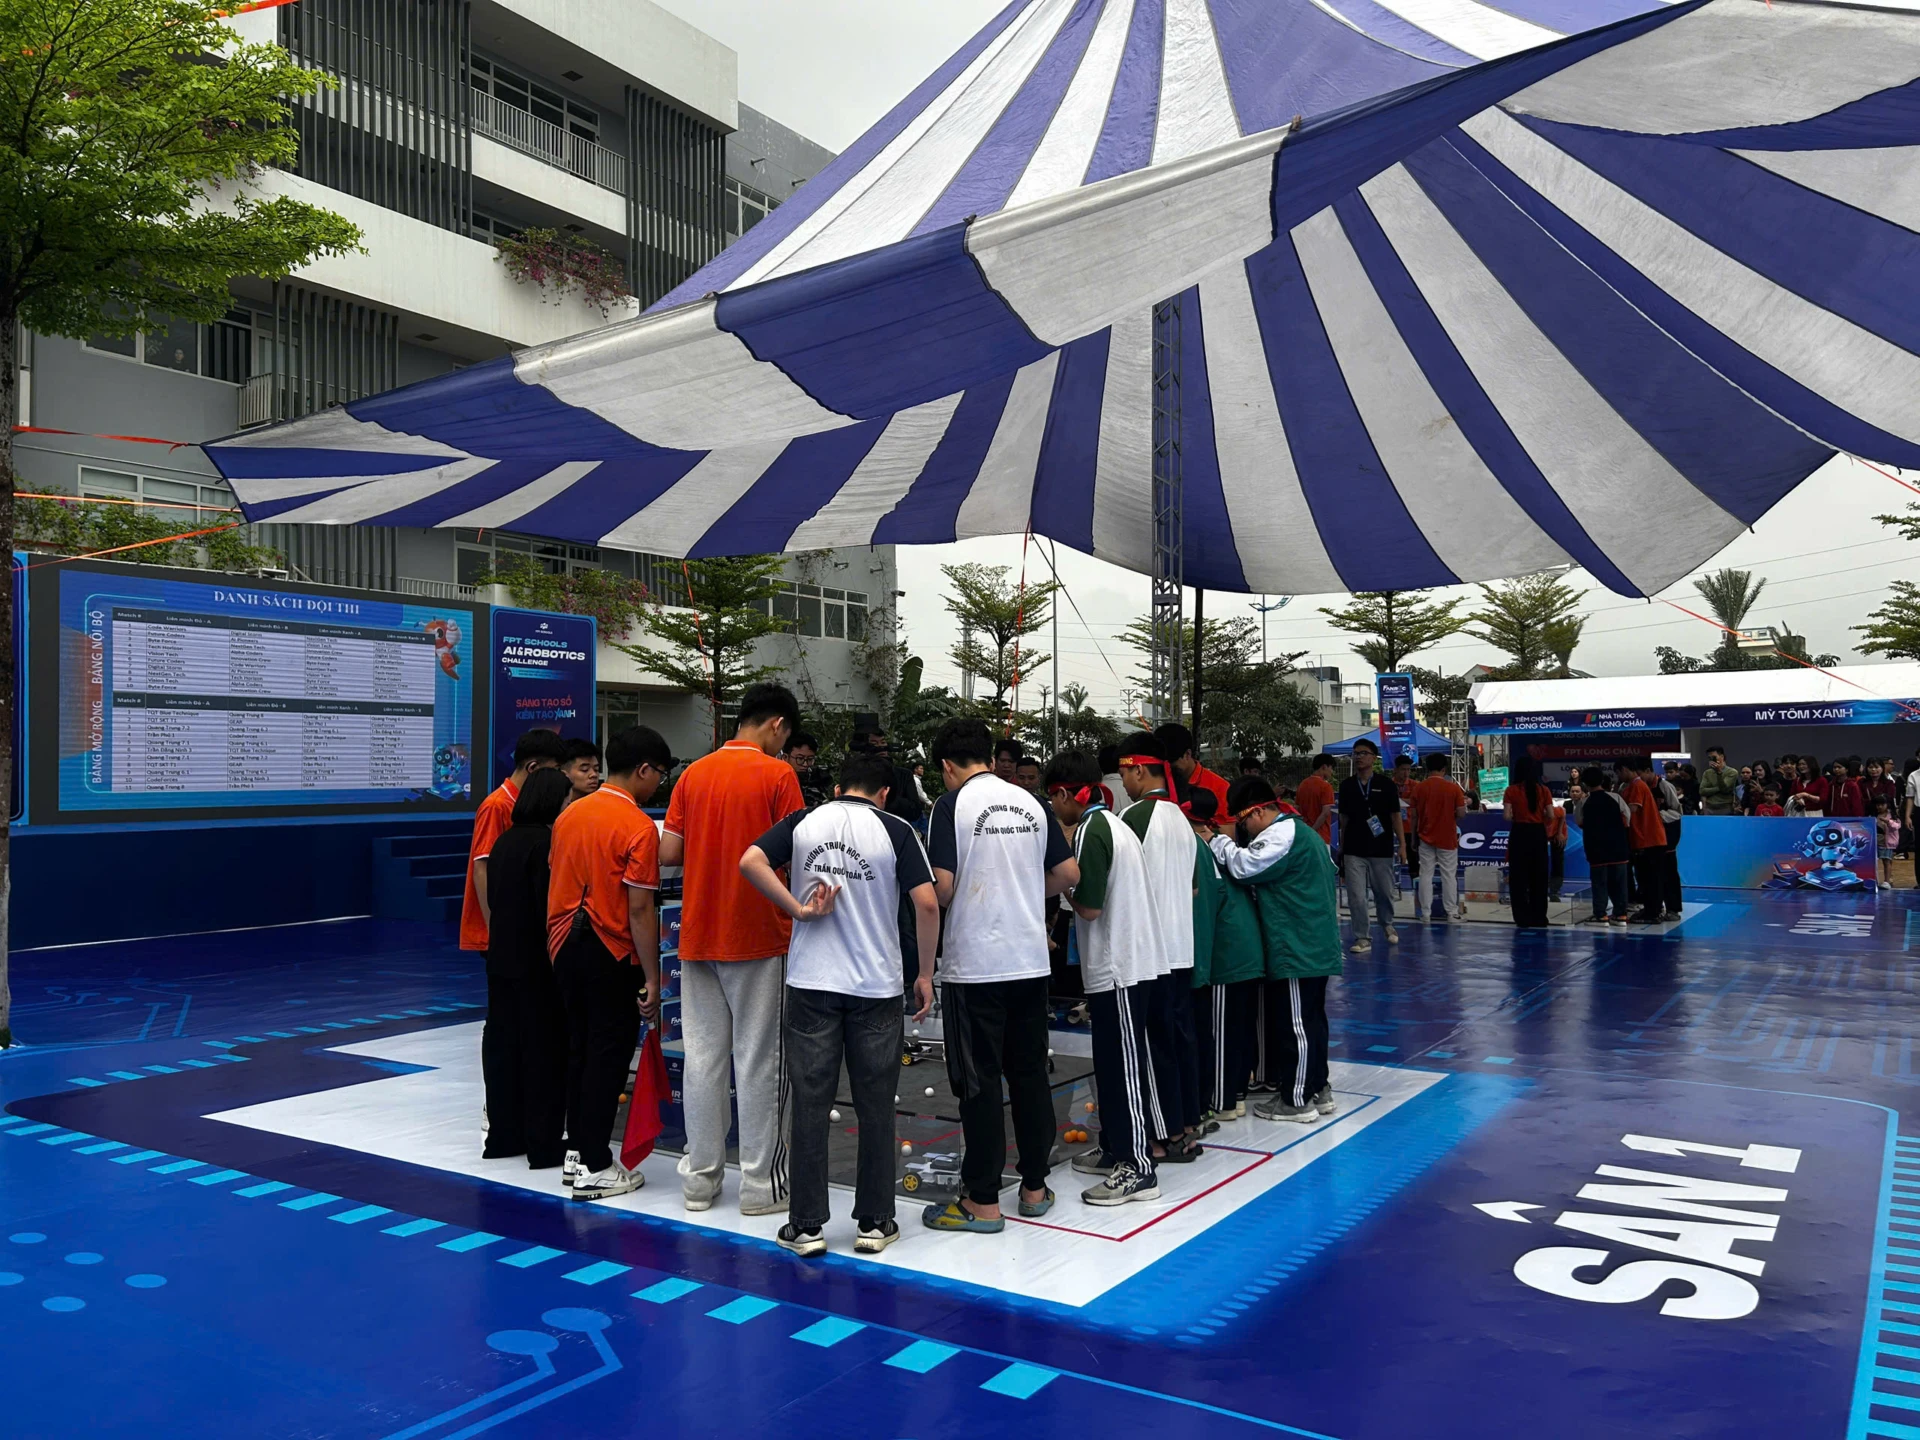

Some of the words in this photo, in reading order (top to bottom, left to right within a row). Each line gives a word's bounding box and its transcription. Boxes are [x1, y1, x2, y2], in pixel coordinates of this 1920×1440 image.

[215, 591, 258, 605] DANH
[262, 594, 302, 609] SÁCH
[307, 600, 332, 613] ĐỘI
[336, 603, 360, 614] THI
[524, 638, 567, 648] SCHOOLS
[503, 646, 585, 660] AI&ROBOTICS
[502, 657, 548, 666] CHALLENGE
[516, 697, 540, 707] SÁNG
[541, 698, 559, 708] TẠO
[89, 701, 104, 730] RỘNG
[554, 708, 575, 720] XANH
[1755, 709, 1775, 720] MỲ
[1778, 708, 1809, 719] TÔM
[1812, 708, 1853, 718] XANH
[1612, 747, 1640, 755] CHÂU
[88, 754, 102, 783] BẢNG
[988, 804, 1008, 814] TRUNG
[1010, 805, 1024, 815] HỌC
[1024, 812, 1034, 823] CƠ
[846, 846, 860, 860] HỌC
[858, 858, 870, 870] CƠ
[1620, 1133, 1802, 1173] 1
[1471, 1164, 1789, 1320] SÂN
